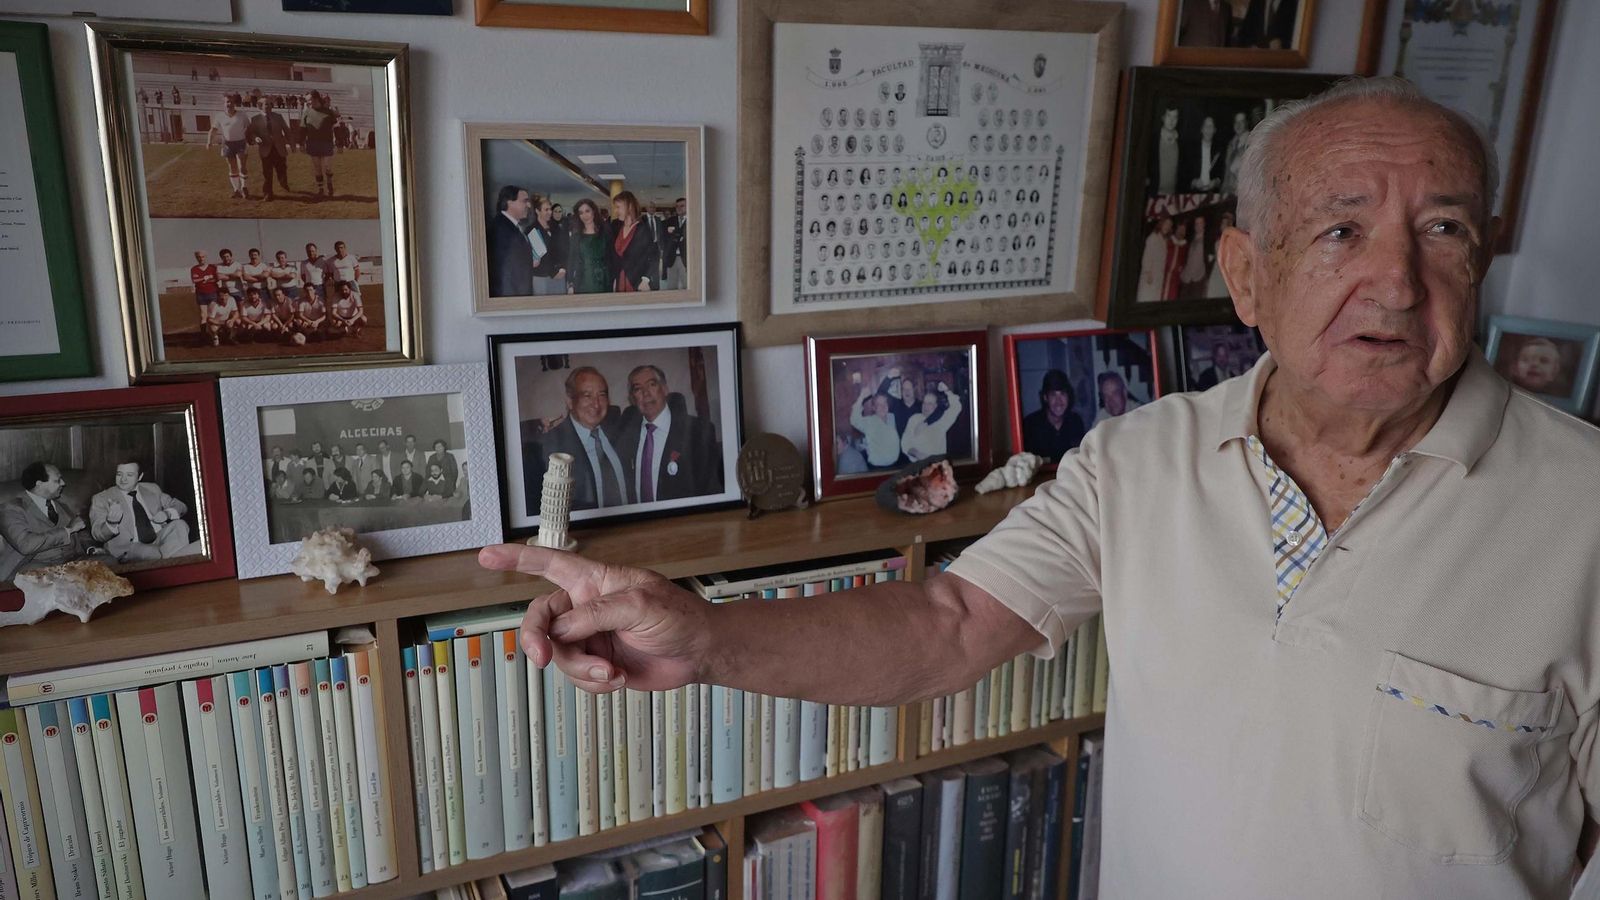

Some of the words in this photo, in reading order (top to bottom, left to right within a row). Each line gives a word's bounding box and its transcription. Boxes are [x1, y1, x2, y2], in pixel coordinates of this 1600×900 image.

[872, 59, 914, 77] FACULTAD
[340, 426, 402, 440] ALGECIRAS
[183, 661, 209, 669] Orgullo
[217, 656, 239, 664] Austen
[144, 665, 175, 675] prejuicio
[310, 759, 318, 785] presidente
[330, 765, 339, 791] personajes
[273, 770, 282, 806] extraordinarios
[252, 786, 261, 820] Frankenstein
[18, 801, 30, 835] Capricornio
[115, 820, 126, 840] jugador
[256, 825, 264, 843] Shelley
[26, 843, 35, 864] Trópico
[65, 835, 75, 857] Drácula
[164, 846, 173, 860] Hugo
[71, 863, 79, 881] Stoker
[74, 882, 82, 897] Bram
[103, 877, 111, 898] Ernesto
